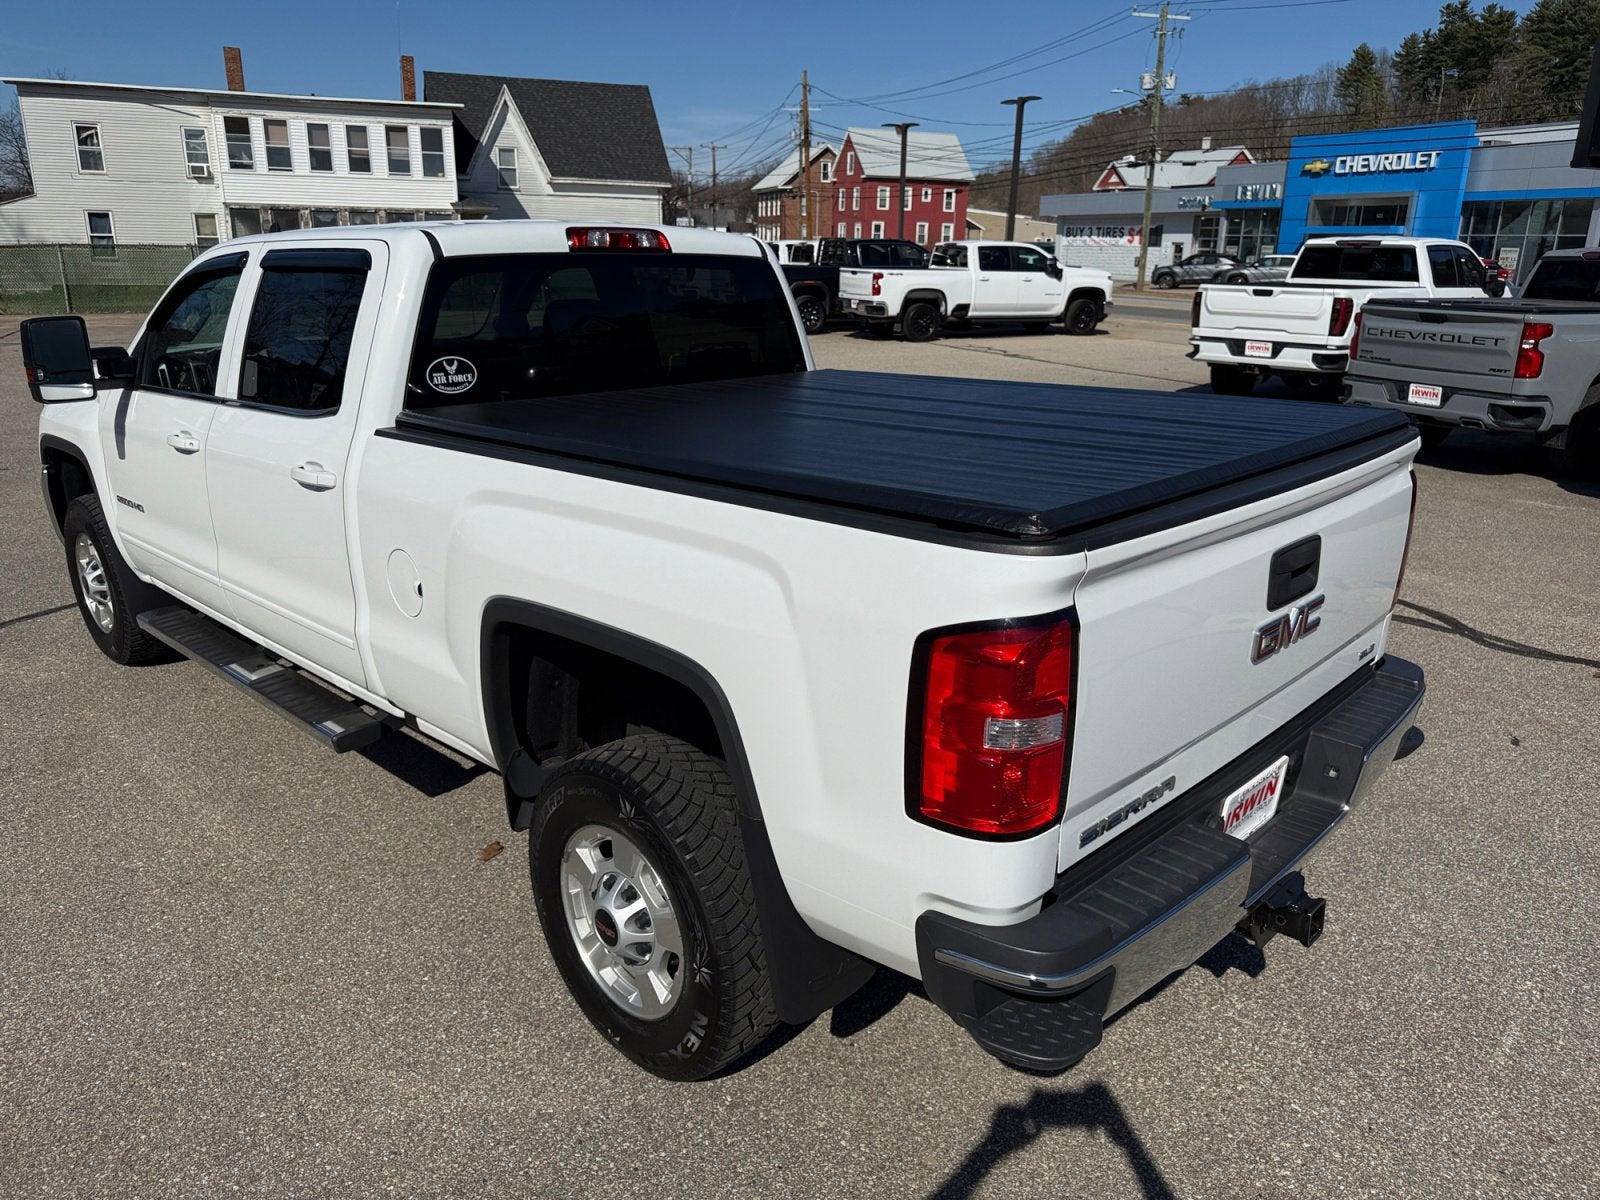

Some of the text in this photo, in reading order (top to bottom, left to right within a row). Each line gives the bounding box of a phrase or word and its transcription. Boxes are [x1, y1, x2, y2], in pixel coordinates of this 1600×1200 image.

[1335, 151, 1441, 174] CHEVROLET
[1236, 183, 1281, 202] IRWIN
[1065, 226, 1084, 238] BUY
[1087, 226, 1093, 238] 3
[1096, 226, 1125, 239] TIRES
[1367, 327, 1505, 347] CHEVROLET
[432, 376, 447, 385] AIR
[448, 374, 473, 384] FORCE
[1411, 388, 1439, 398] IRWIN
[1251, 593, 1326, 666] GMC
[1079, 775, 1176, 850] SIERRA
[1223, 775, 1279, 833] IRWIN
